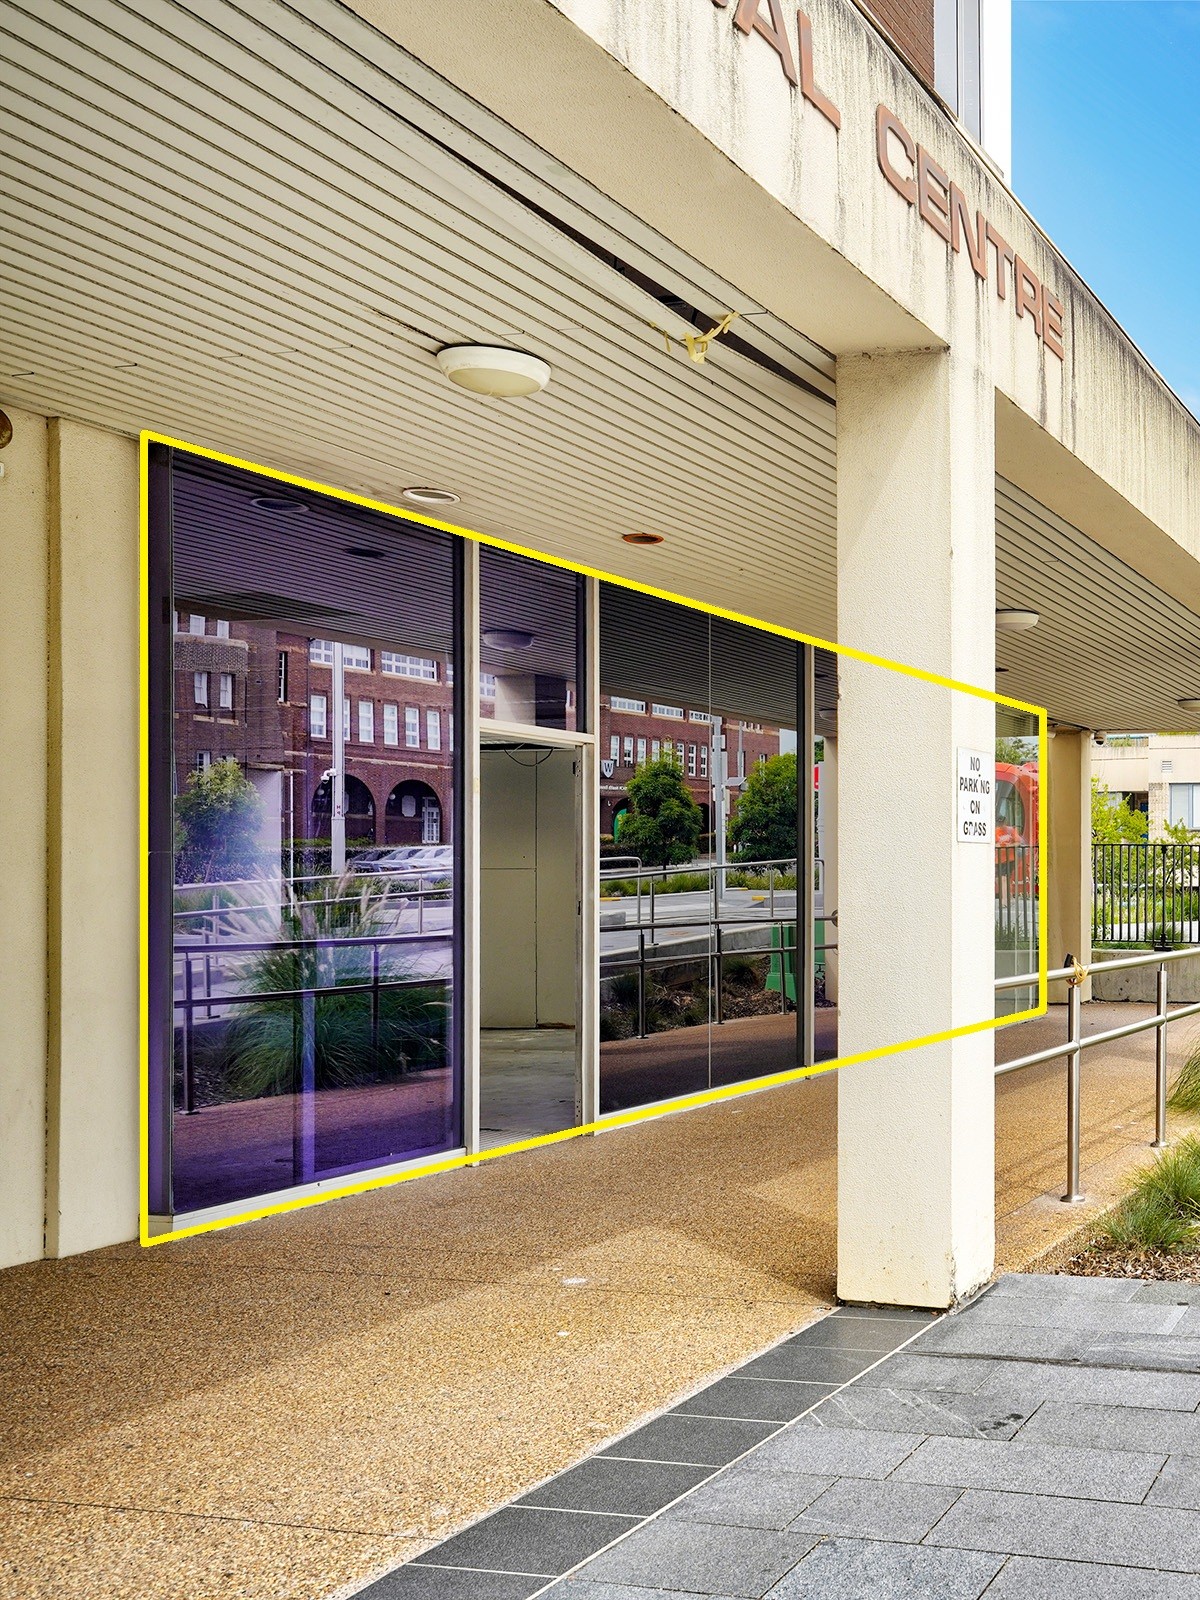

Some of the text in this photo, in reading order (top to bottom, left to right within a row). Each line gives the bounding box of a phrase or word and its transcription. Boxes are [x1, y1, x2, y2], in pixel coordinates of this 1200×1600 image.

[711, 0, 1064, 361] AL CENTRE
[970, 756, 981, 771] NO
[959, 776, 990, 795] PARKNG
